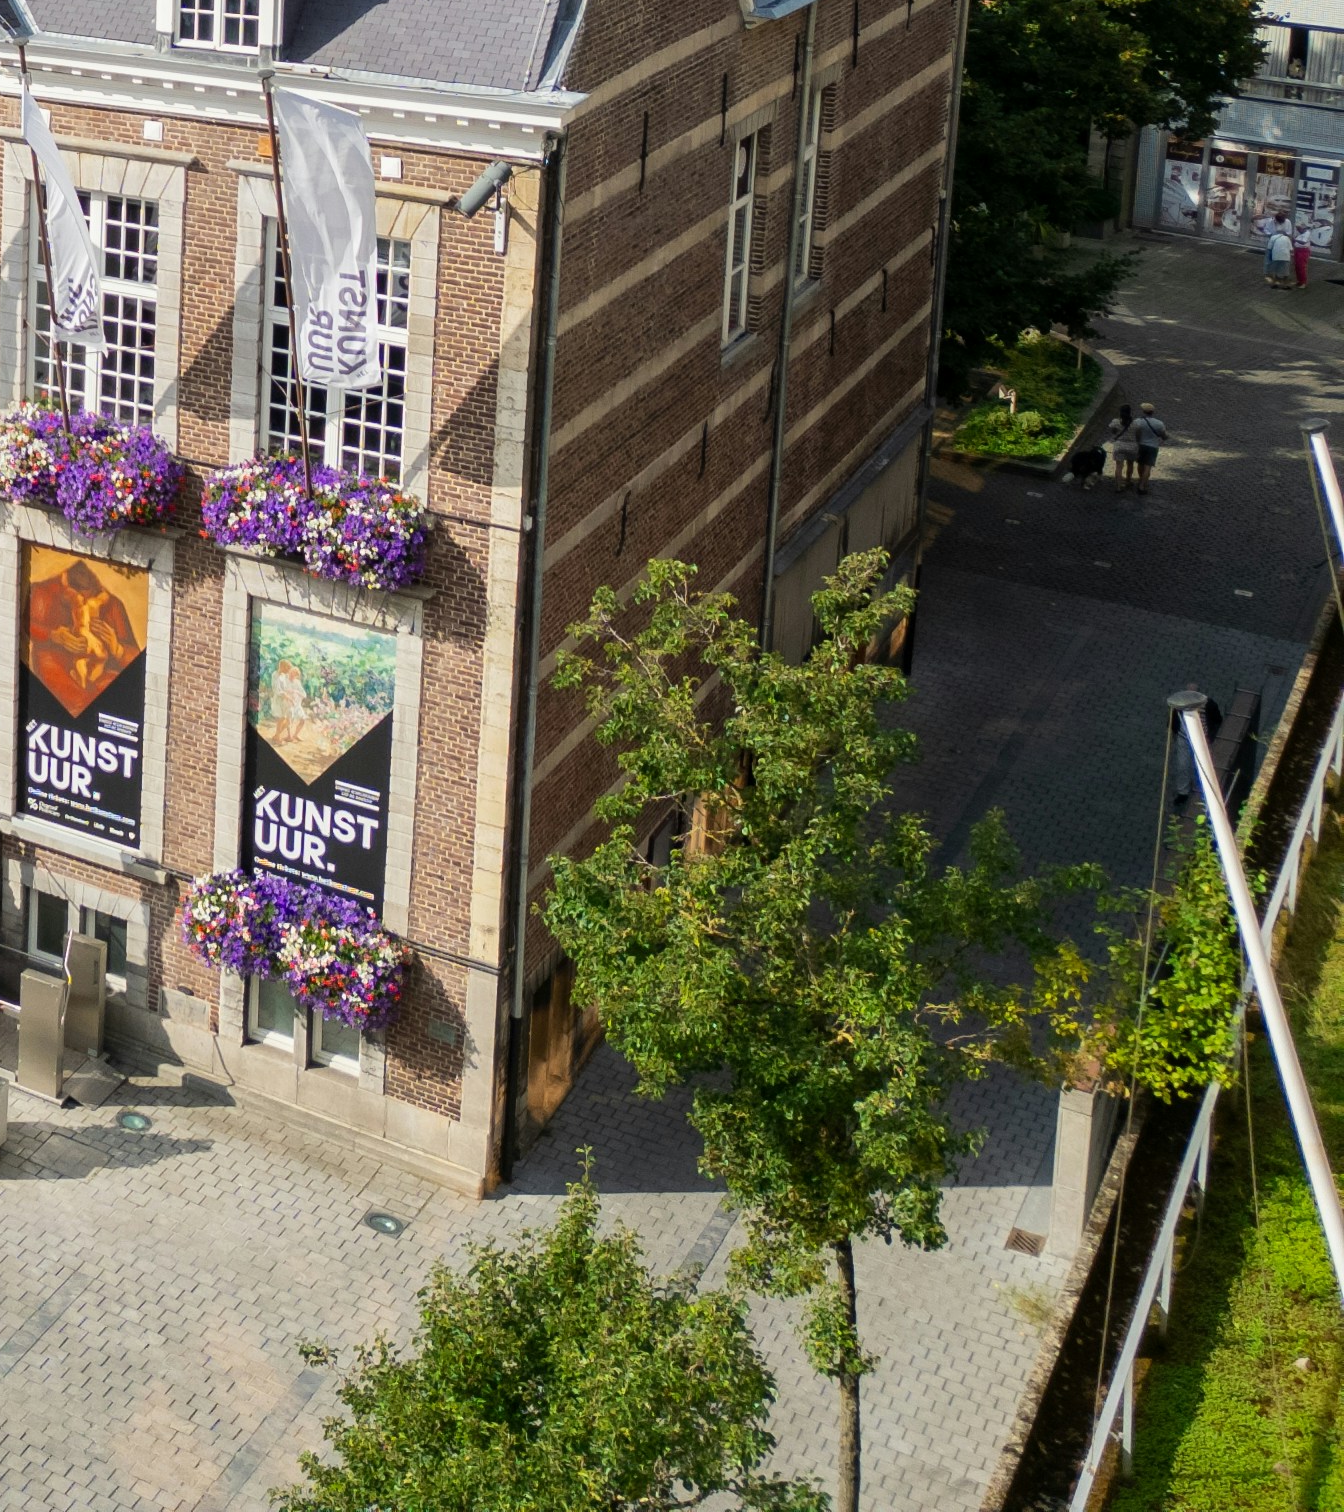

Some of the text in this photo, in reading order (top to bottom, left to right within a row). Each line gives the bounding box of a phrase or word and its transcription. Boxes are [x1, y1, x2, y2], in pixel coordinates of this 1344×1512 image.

[28, 722, 139, 779] KUNST
[28, 750, 101, 802] UUR.
[254, 817, 336, 873] UUR.
[255, 789, 380, 850] KUNST
